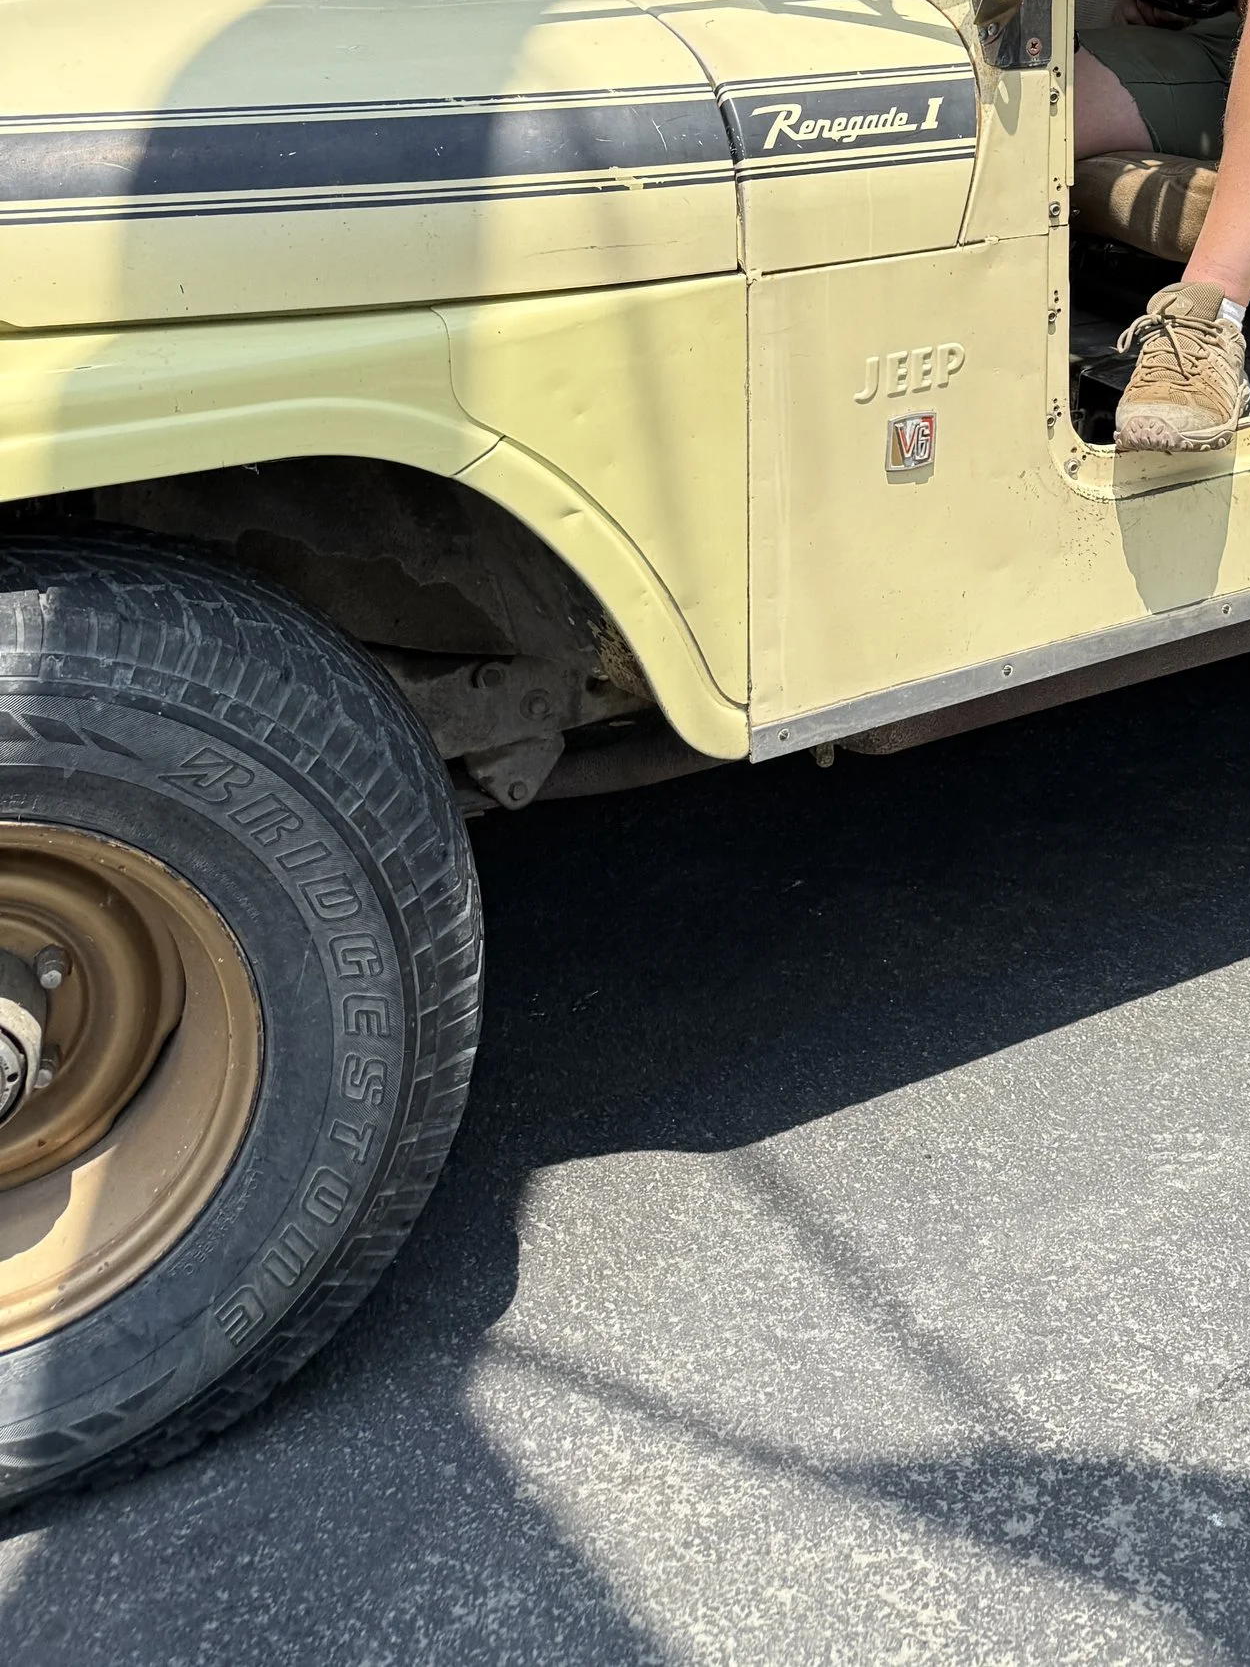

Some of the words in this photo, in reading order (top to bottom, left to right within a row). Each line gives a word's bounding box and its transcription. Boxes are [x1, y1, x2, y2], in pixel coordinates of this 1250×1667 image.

[749, 103, 917, 150] Renegade
[853, 342, 966, 405] JEEP
[894, 420, 932, 462] V6
[157, 747, 391, 1347] BRIDGESTONE
